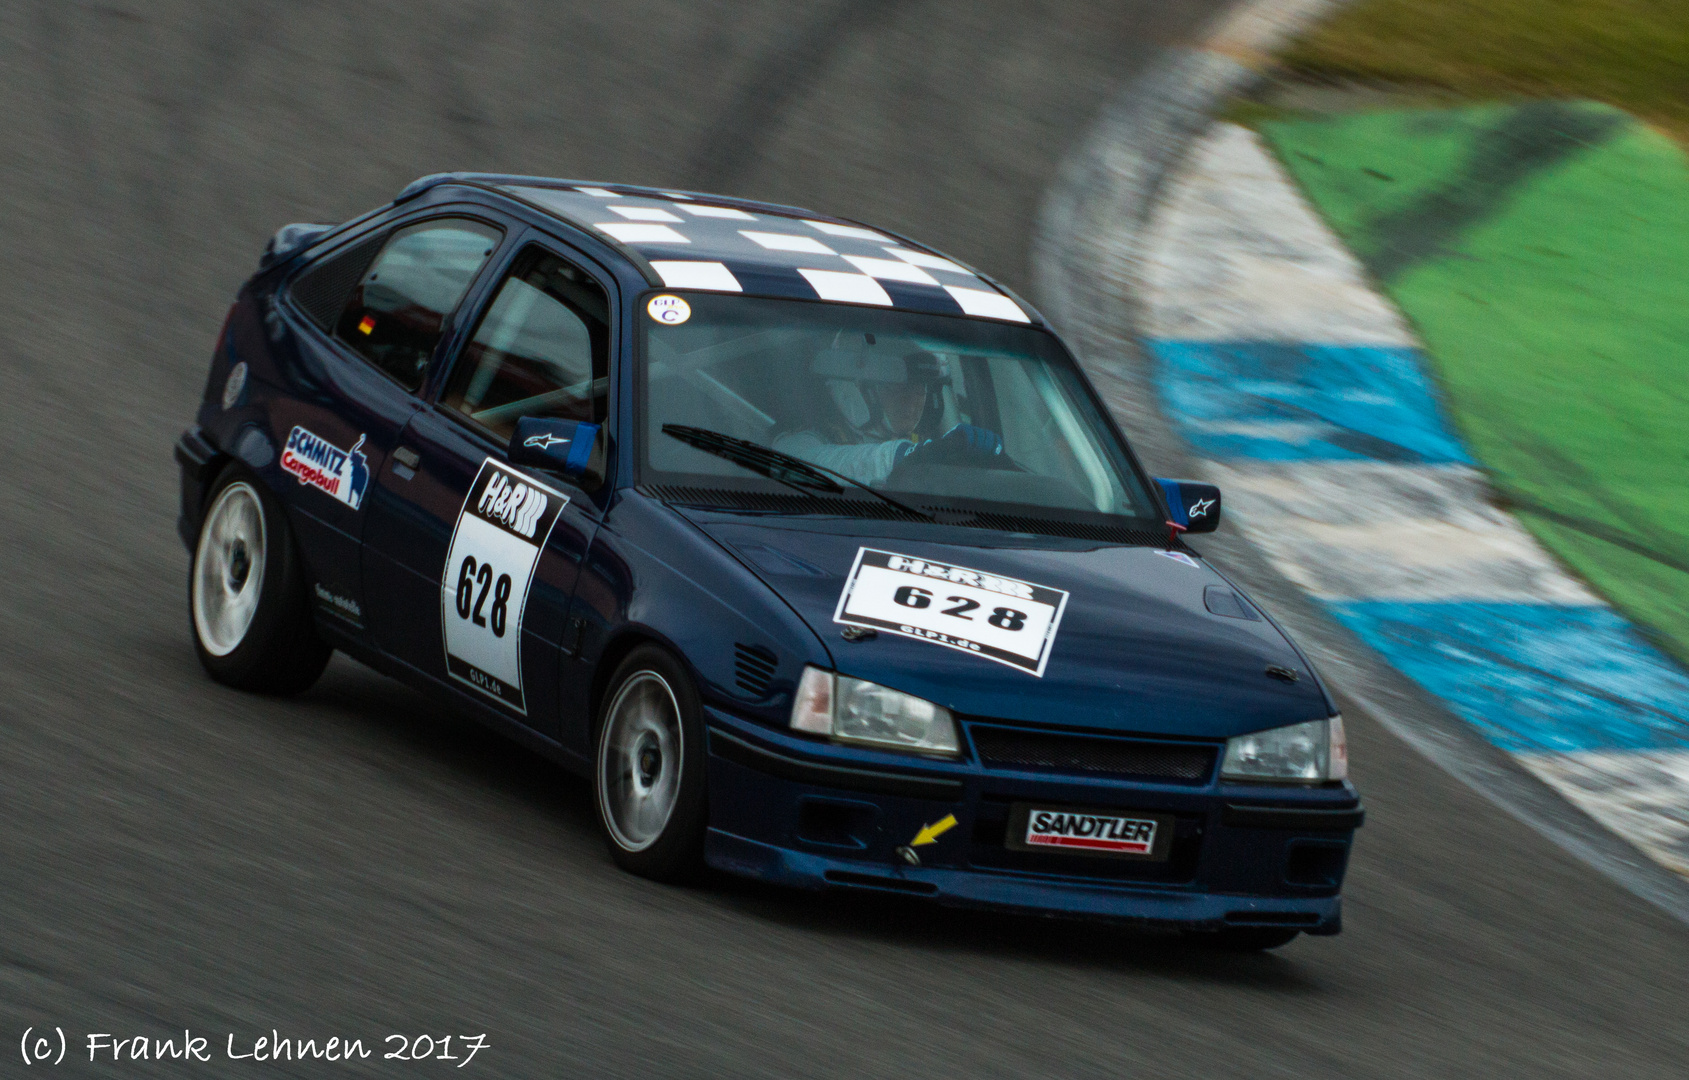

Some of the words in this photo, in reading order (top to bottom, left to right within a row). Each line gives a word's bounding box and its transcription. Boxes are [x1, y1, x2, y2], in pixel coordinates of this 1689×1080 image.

[662, 310, 679, 322] C
[288, 427, 348, 477] SCHMITZ
[283, 451, 340, 496] Cargobull
[456, 555, 512, 638] 628
[893, 585, 1028, 632] 628
[900, 624, 981, 651] GLP1.de
[469, 668, 502, 696] GLP1.de
[1032, 812, 1154, 843] SANDTLER
